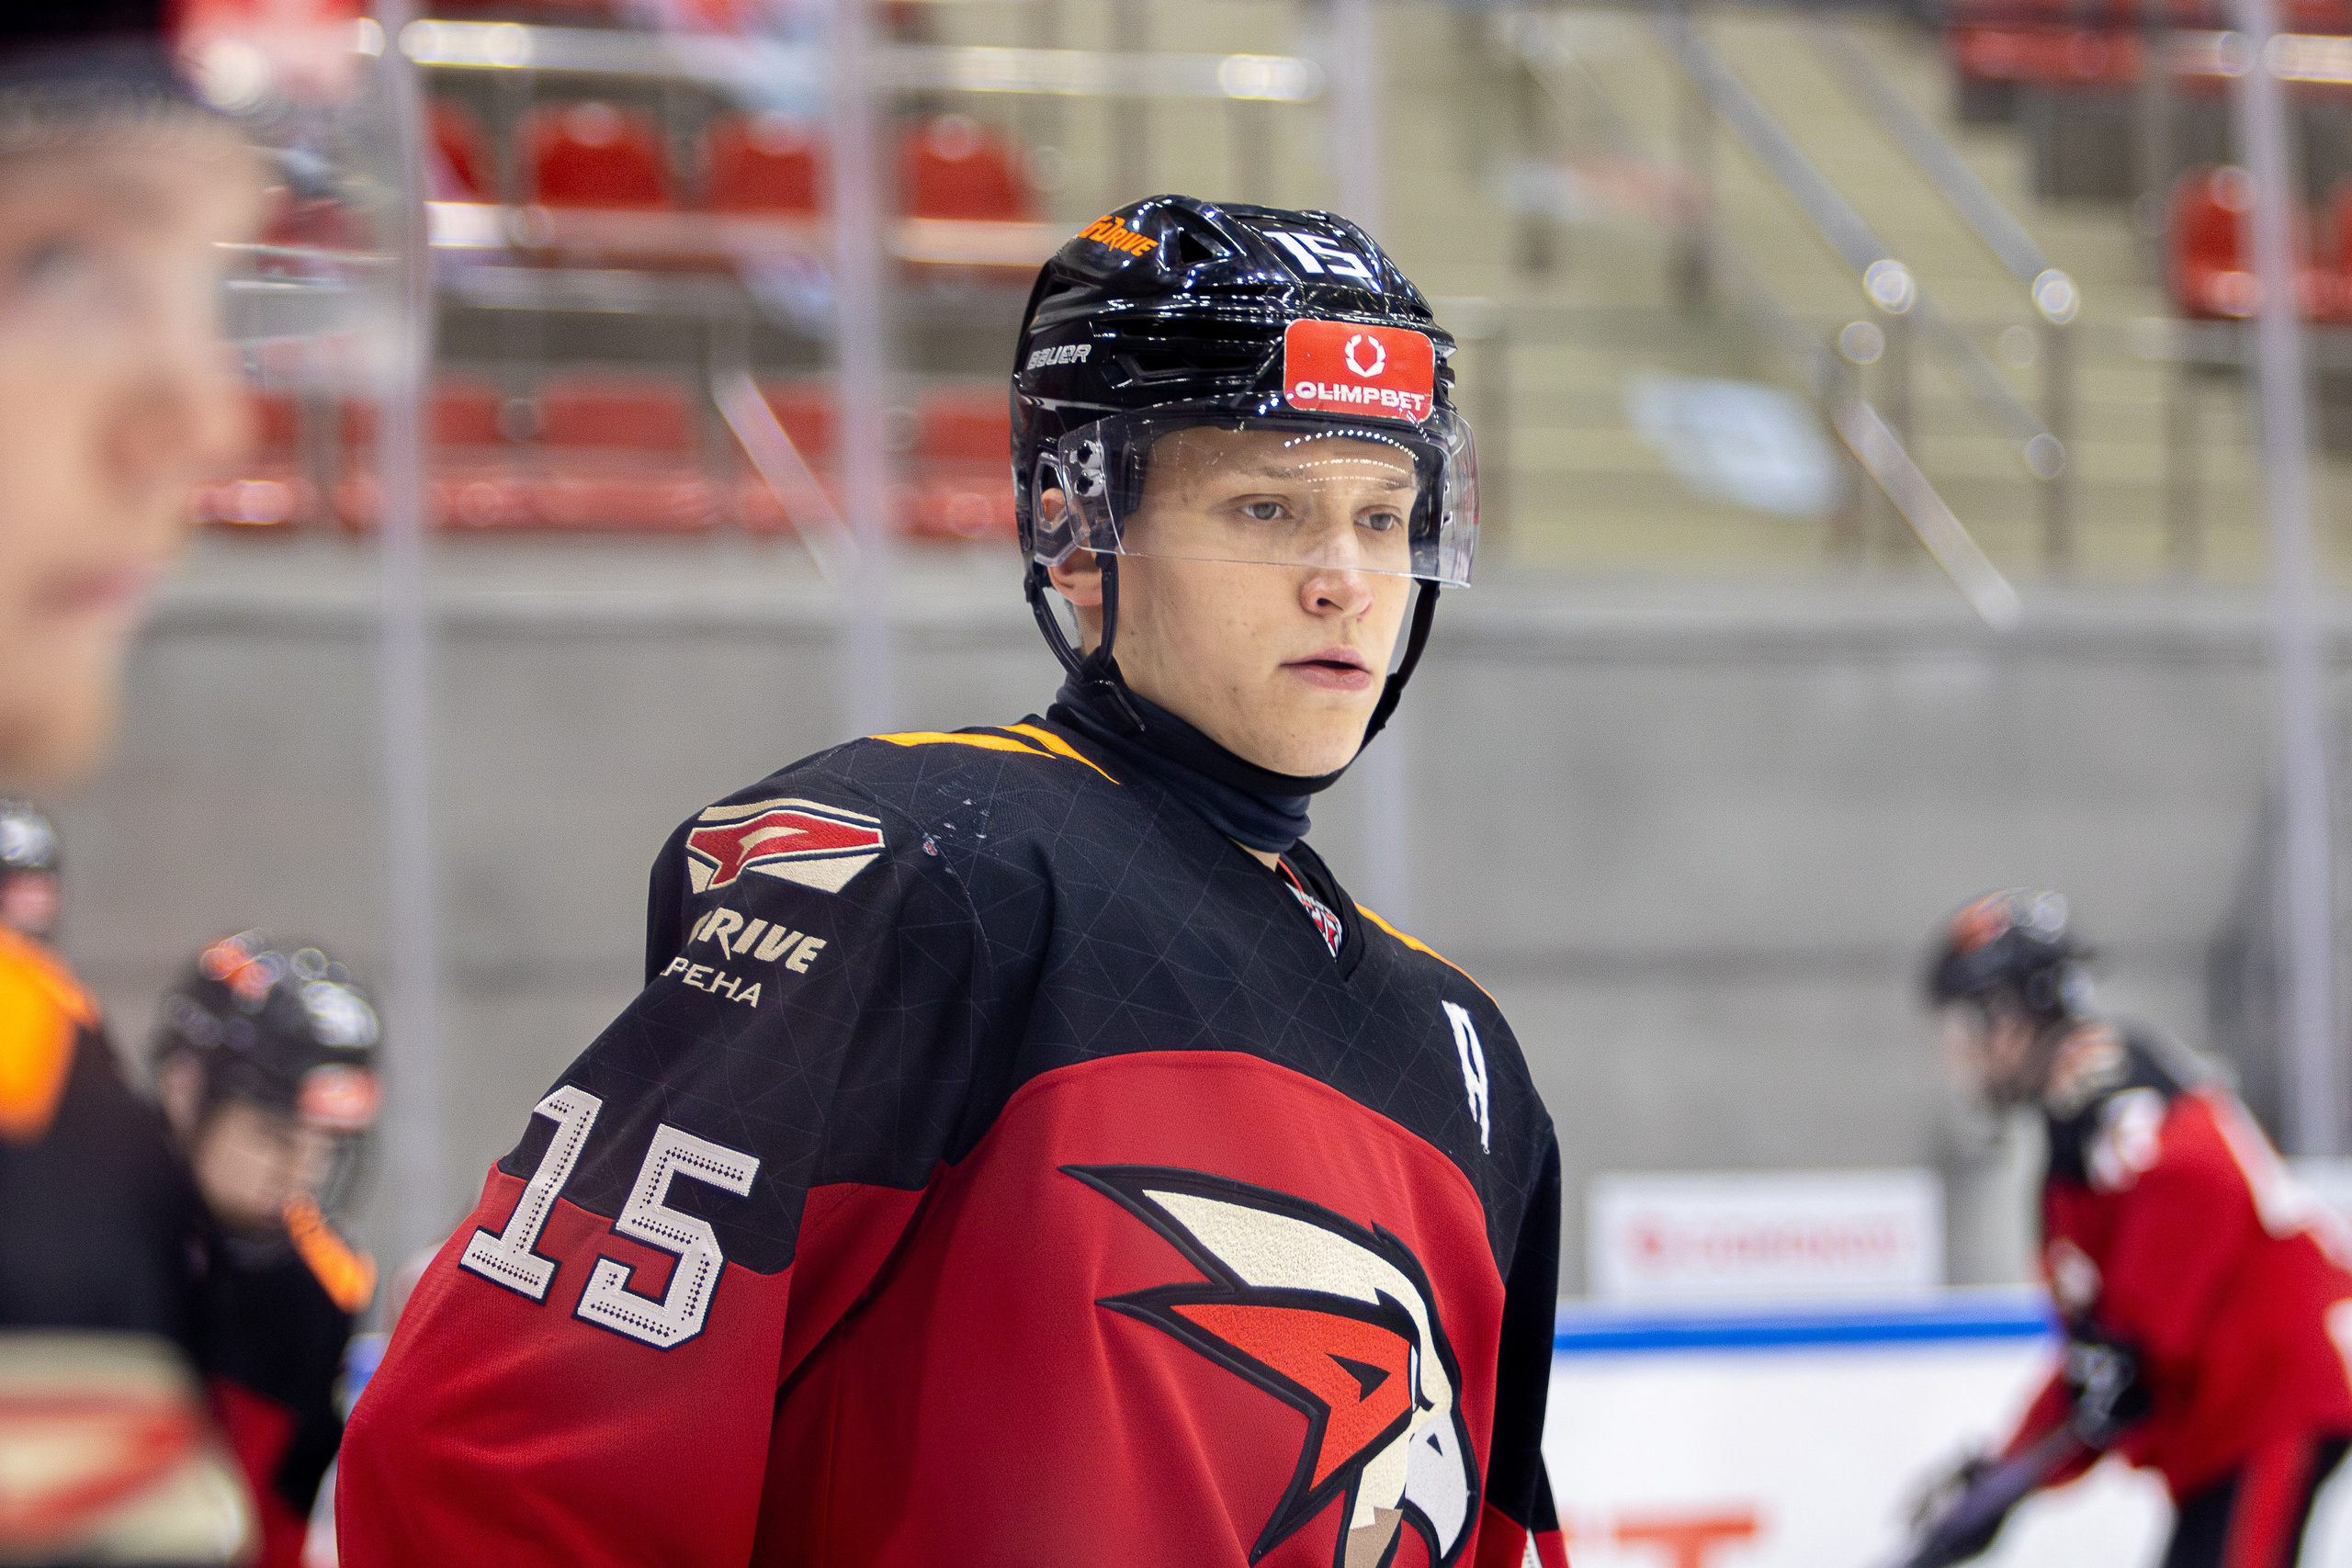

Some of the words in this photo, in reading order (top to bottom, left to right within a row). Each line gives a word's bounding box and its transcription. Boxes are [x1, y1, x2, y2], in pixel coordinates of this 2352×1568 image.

[1262, 231, 1373, 277] 15
[1027, 344, 1091, 370] BAUER
[1295, 381, 1425, 411] OLIMPBET
[687, 906, 827, 974] RIVE
[660, 956, 762, 1008] РЕНА
[1442, 999, 1490, 1155] A
[458, 1082, 761, 1351] 15
